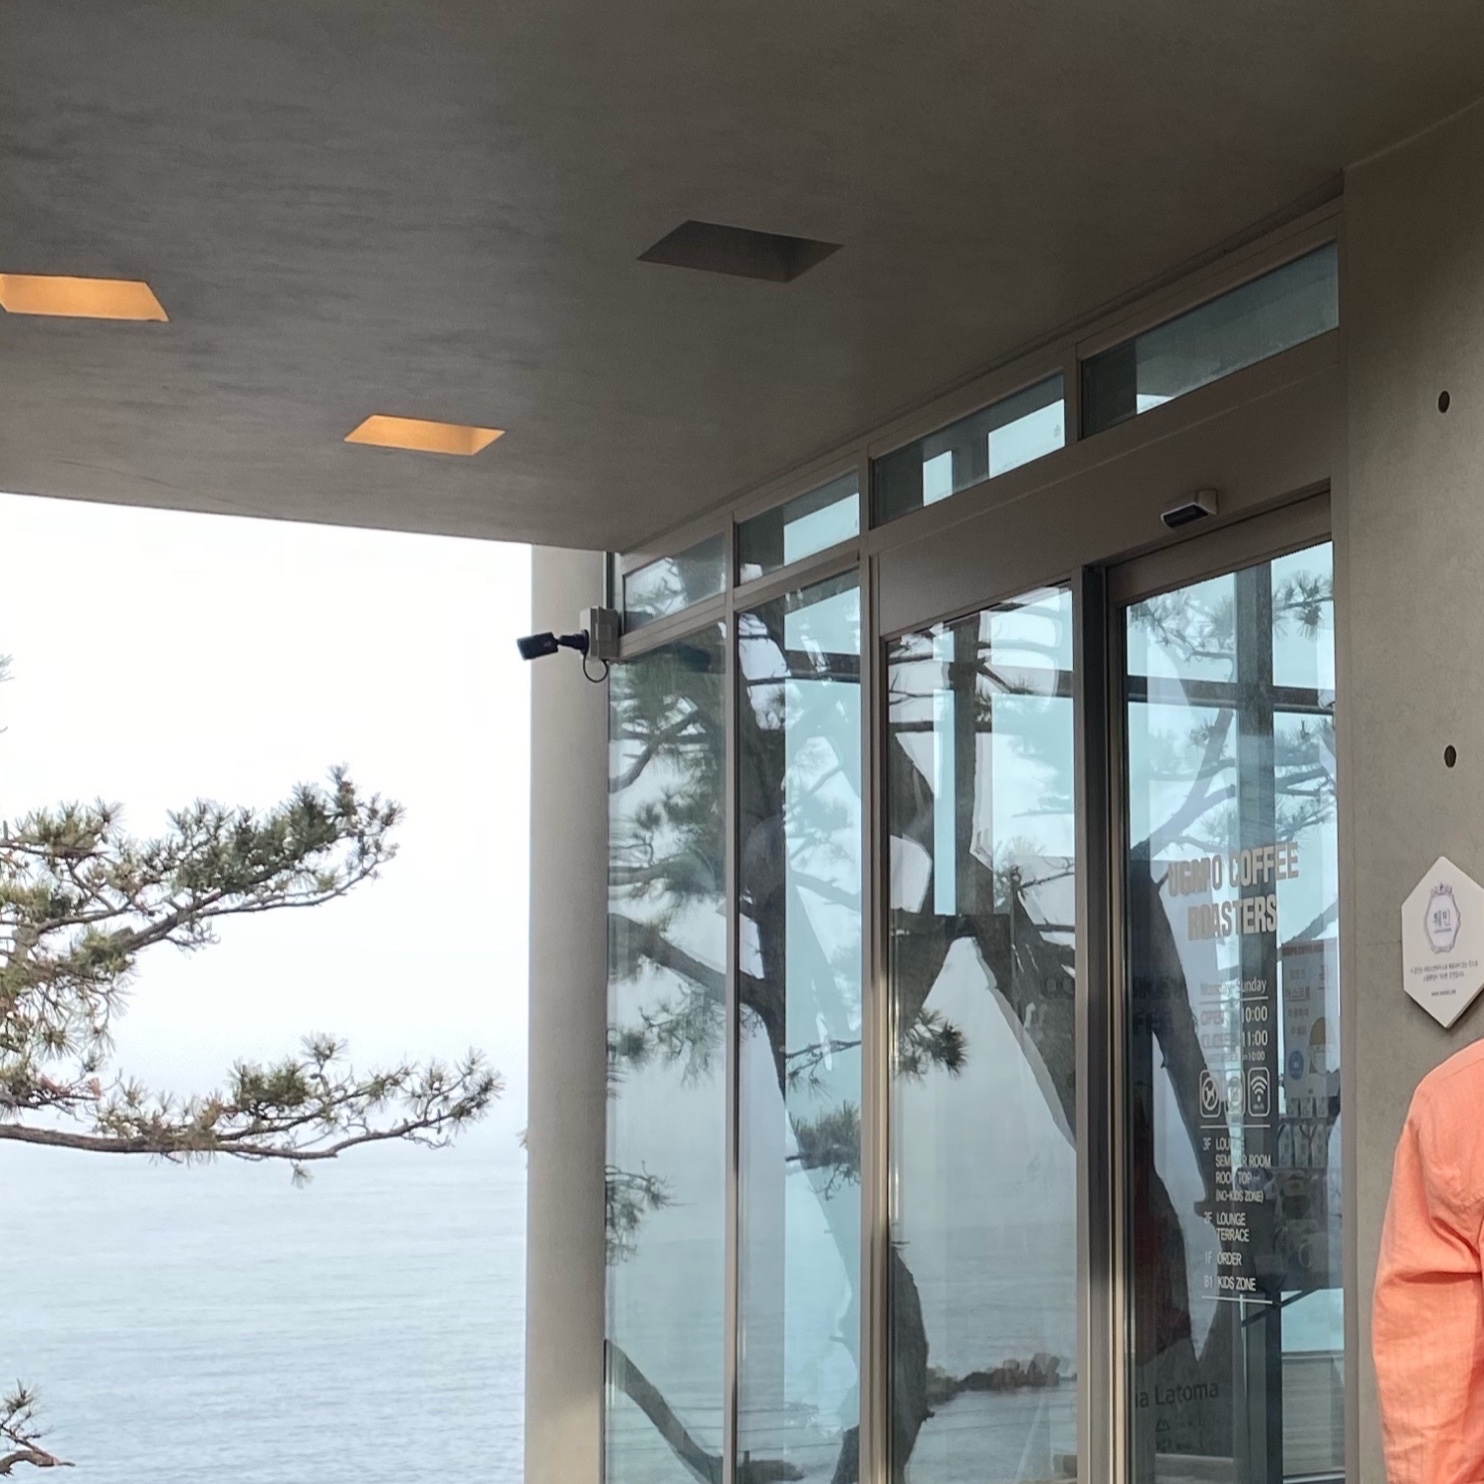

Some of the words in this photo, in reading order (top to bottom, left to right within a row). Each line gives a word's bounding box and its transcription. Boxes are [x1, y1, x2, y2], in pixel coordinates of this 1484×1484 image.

[1229, 842, 1299, 888] COFFEE
[1187, 894, 1278, 941] ROASTERS
[1202, 1137, 1212, 1152] 3F
[1248, 1154, 1272, 1169] ROOM
[1237, 1171, 1253, 1185] TOP
[1244, 1190, 1264, 1204] ZONE)
[1203, 1211, 1213, 1225] 2F
[1216, 1211, 1247, 1226] LOUNGE
[1216, 1228, 1250, 1243] TERRACE
[1216, 1251, 1243, 1267] ORDER
[1217, 1275, 1235, 1290] KIDS
[1235, 1276, 1257, 1292] ZONE
[1154, 1381, 1219, 1406] Latoma
